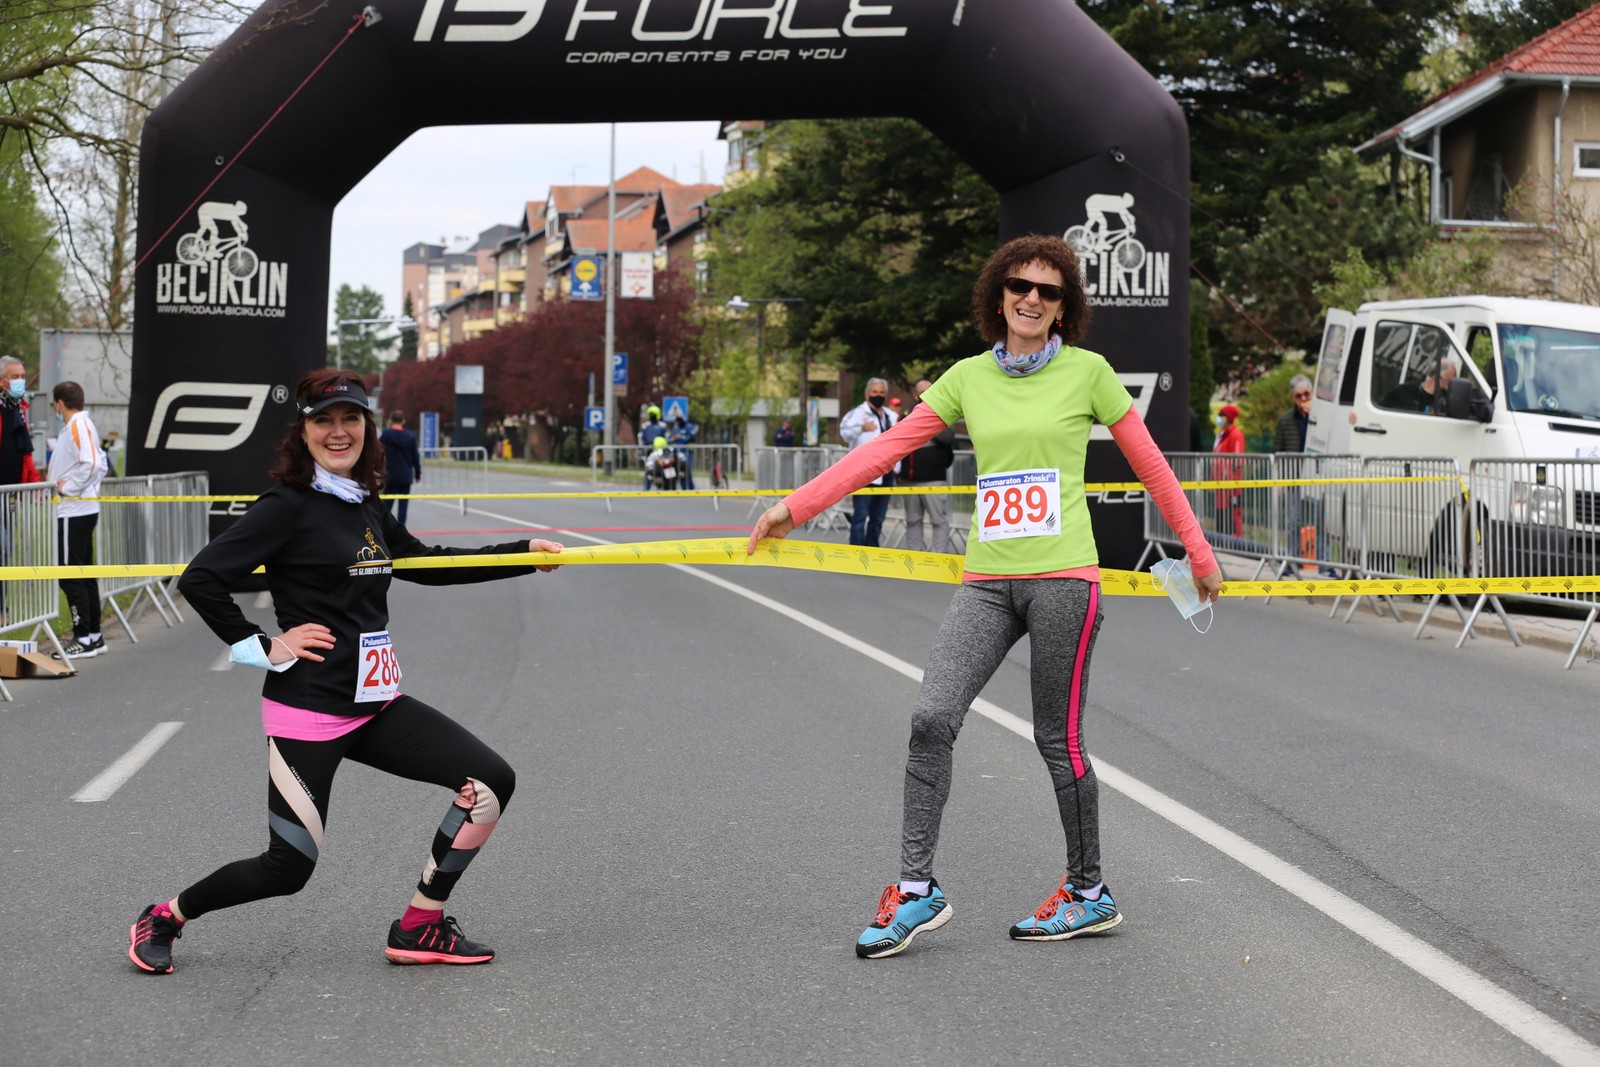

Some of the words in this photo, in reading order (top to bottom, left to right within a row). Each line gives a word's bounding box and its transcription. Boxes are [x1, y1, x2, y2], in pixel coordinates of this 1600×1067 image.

[564, 50, 731, 64] COMPONENTS
[739, 49, 791, 62] FOR
[798, 47, 847, 61] YOU
[157, 260, 288, 307] BECIKLIN
[1075, 252, 1169, 296] CIKLIN
[156, 305, 286, 318] WWW.PRODAJA-BICIKLA.COM
[589, 410, 603, 427] P
[984, 485, 1047, 527] 289
[363, 647, 399, 687] 288
